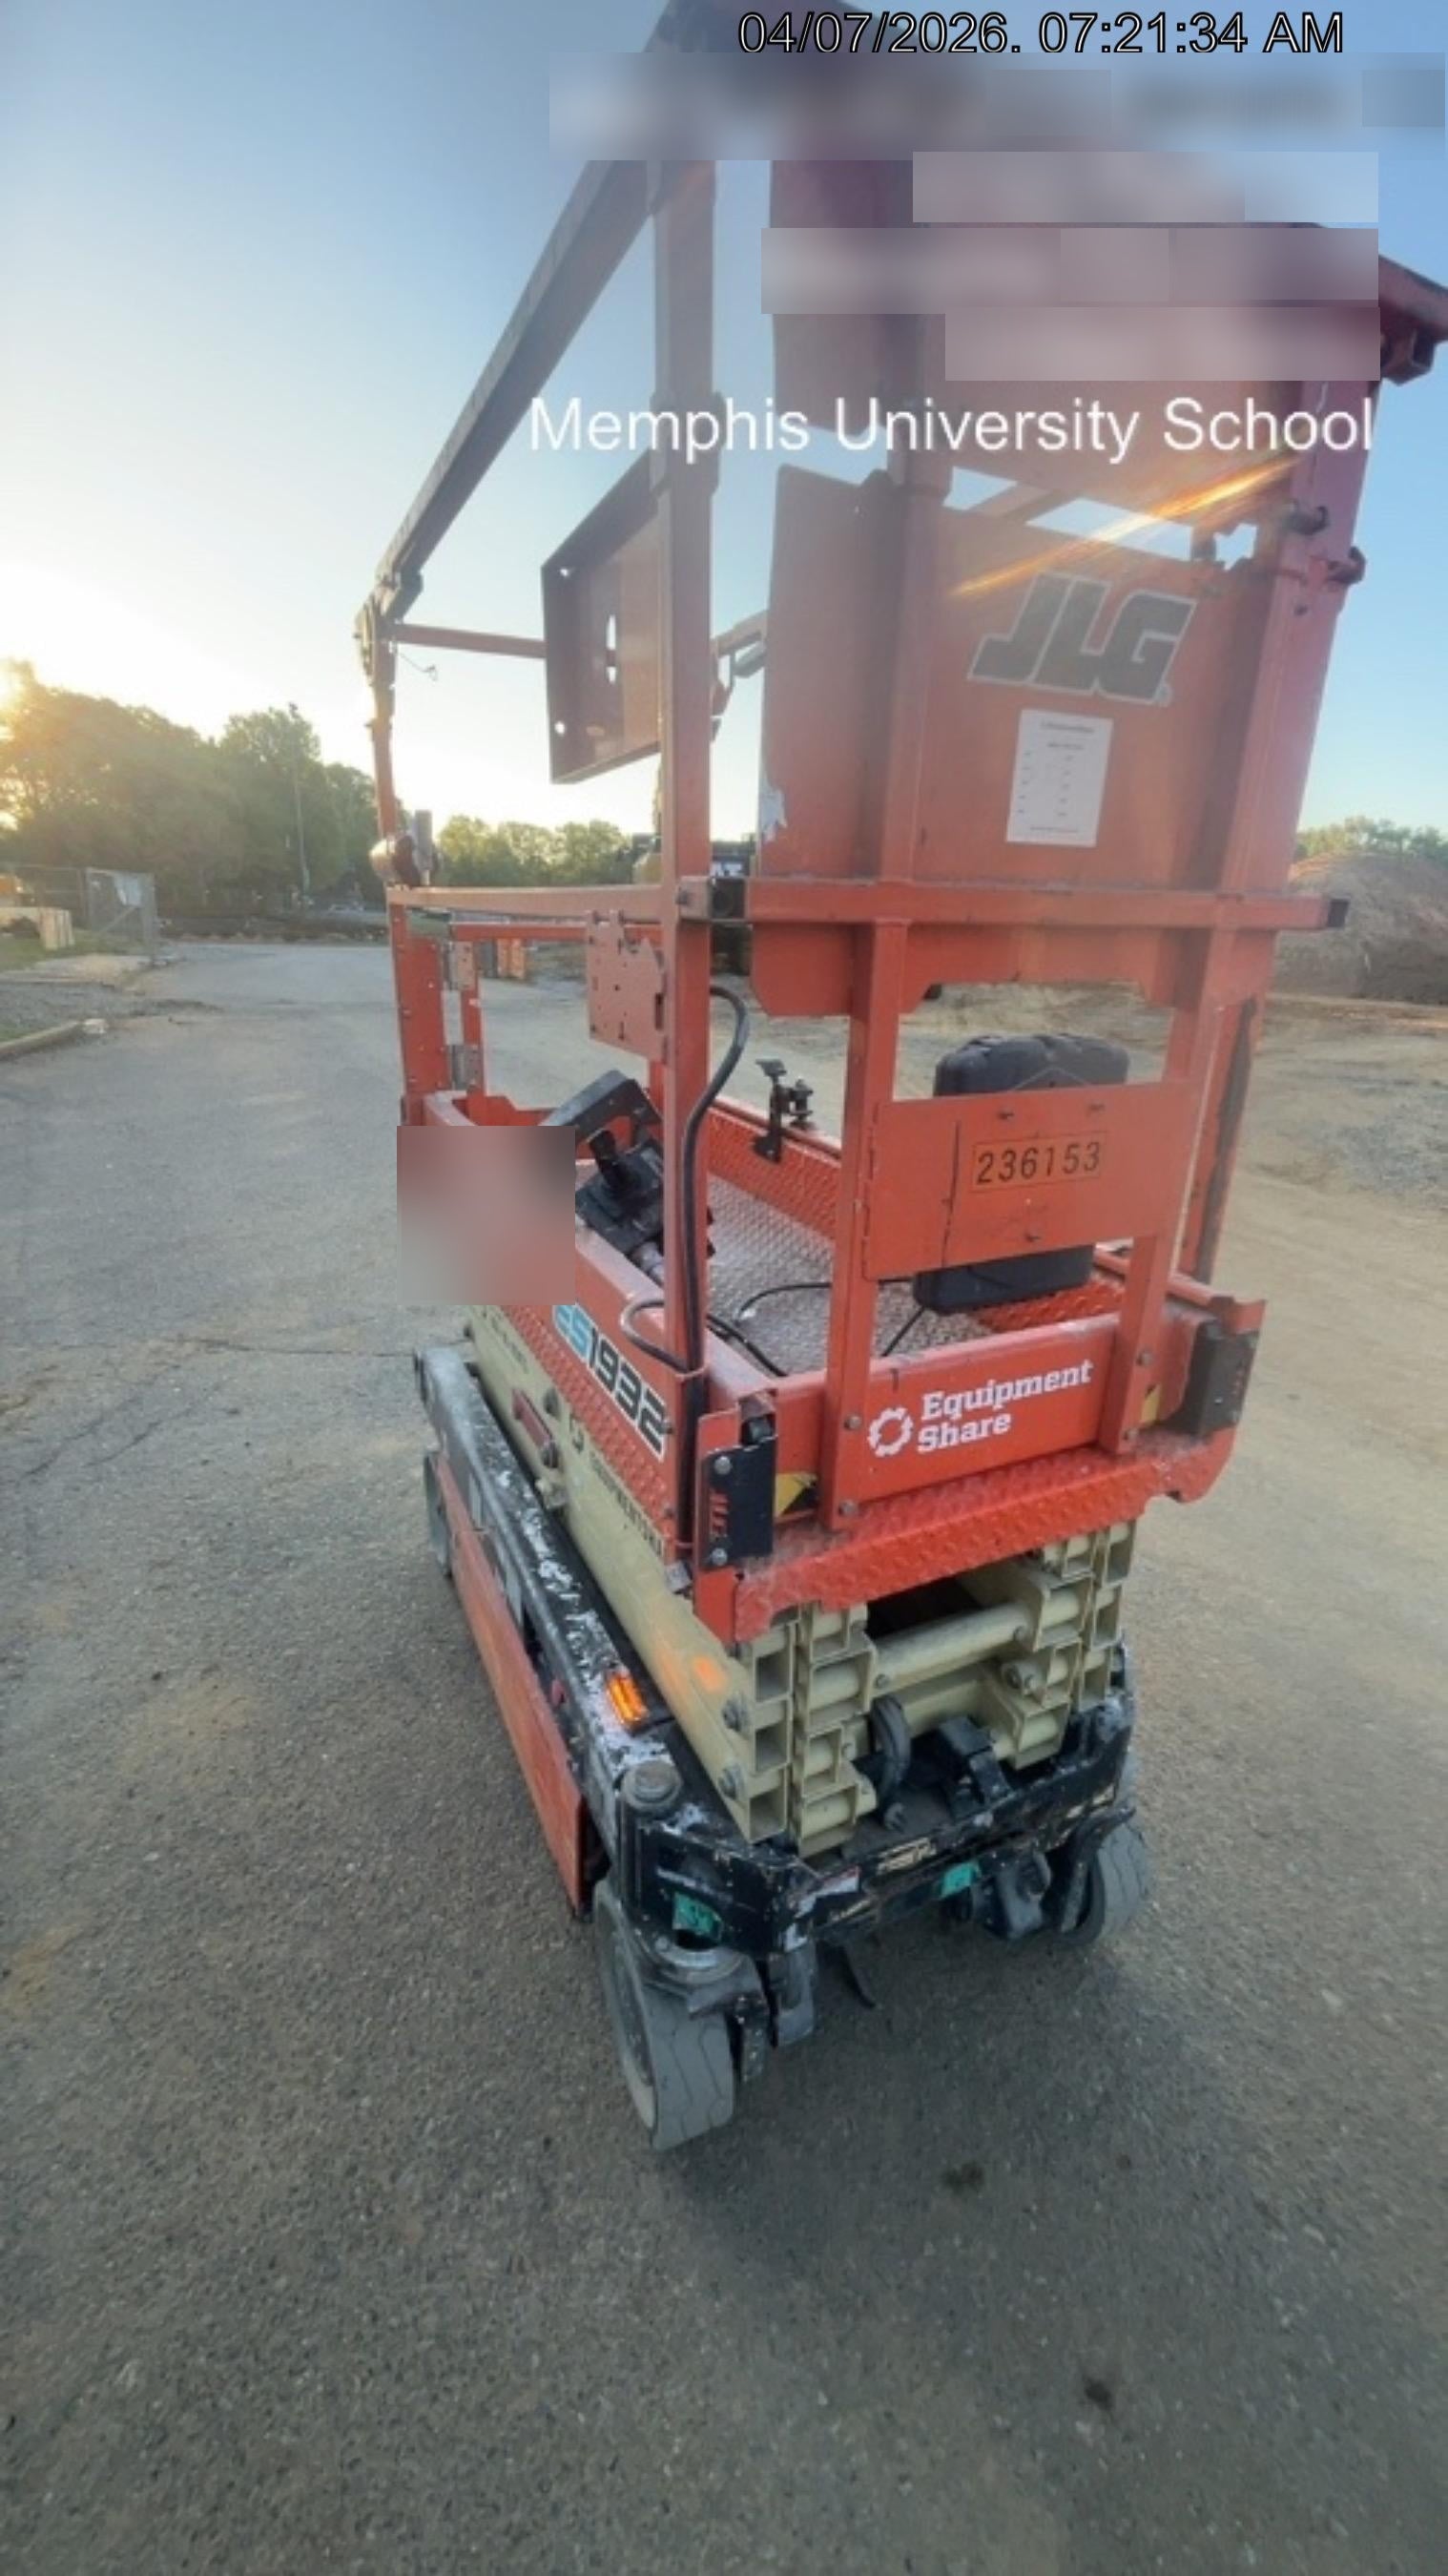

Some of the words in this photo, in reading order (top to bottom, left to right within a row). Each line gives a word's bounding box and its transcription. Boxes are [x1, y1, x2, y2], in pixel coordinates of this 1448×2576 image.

[968, 573, 1196, 705] JLG
[977, 1142, 1100, 1185] 236153
[921, 1359, 1093, 1422] Equipment
[918, 1411, 1011, 1453] Share
